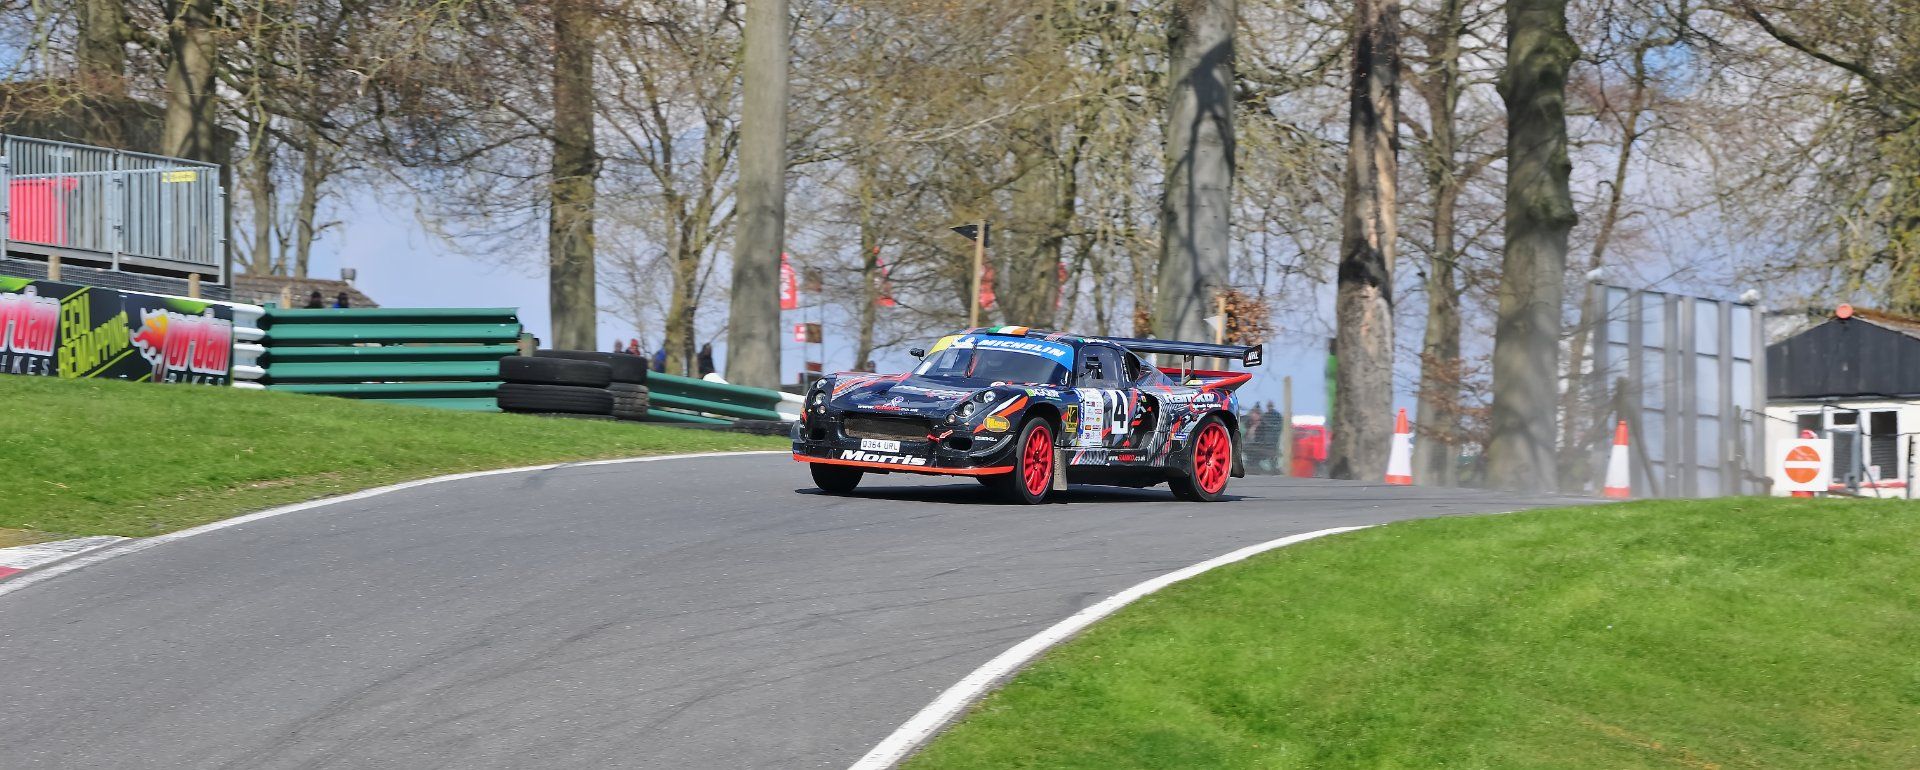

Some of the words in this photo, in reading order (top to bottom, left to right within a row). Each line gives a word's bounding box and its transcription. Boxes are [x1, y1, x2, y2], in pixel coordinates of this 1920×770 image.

[61, 293, 91, 347] ECU
[58, 310, 129, 379] REMAPPING
[977, 339, 1066, 357] MICHELIN
[1114, 390, 1127, 429] 4
[840, 449, 927, 466] Morris
[884, 442, 899, 451] URL
